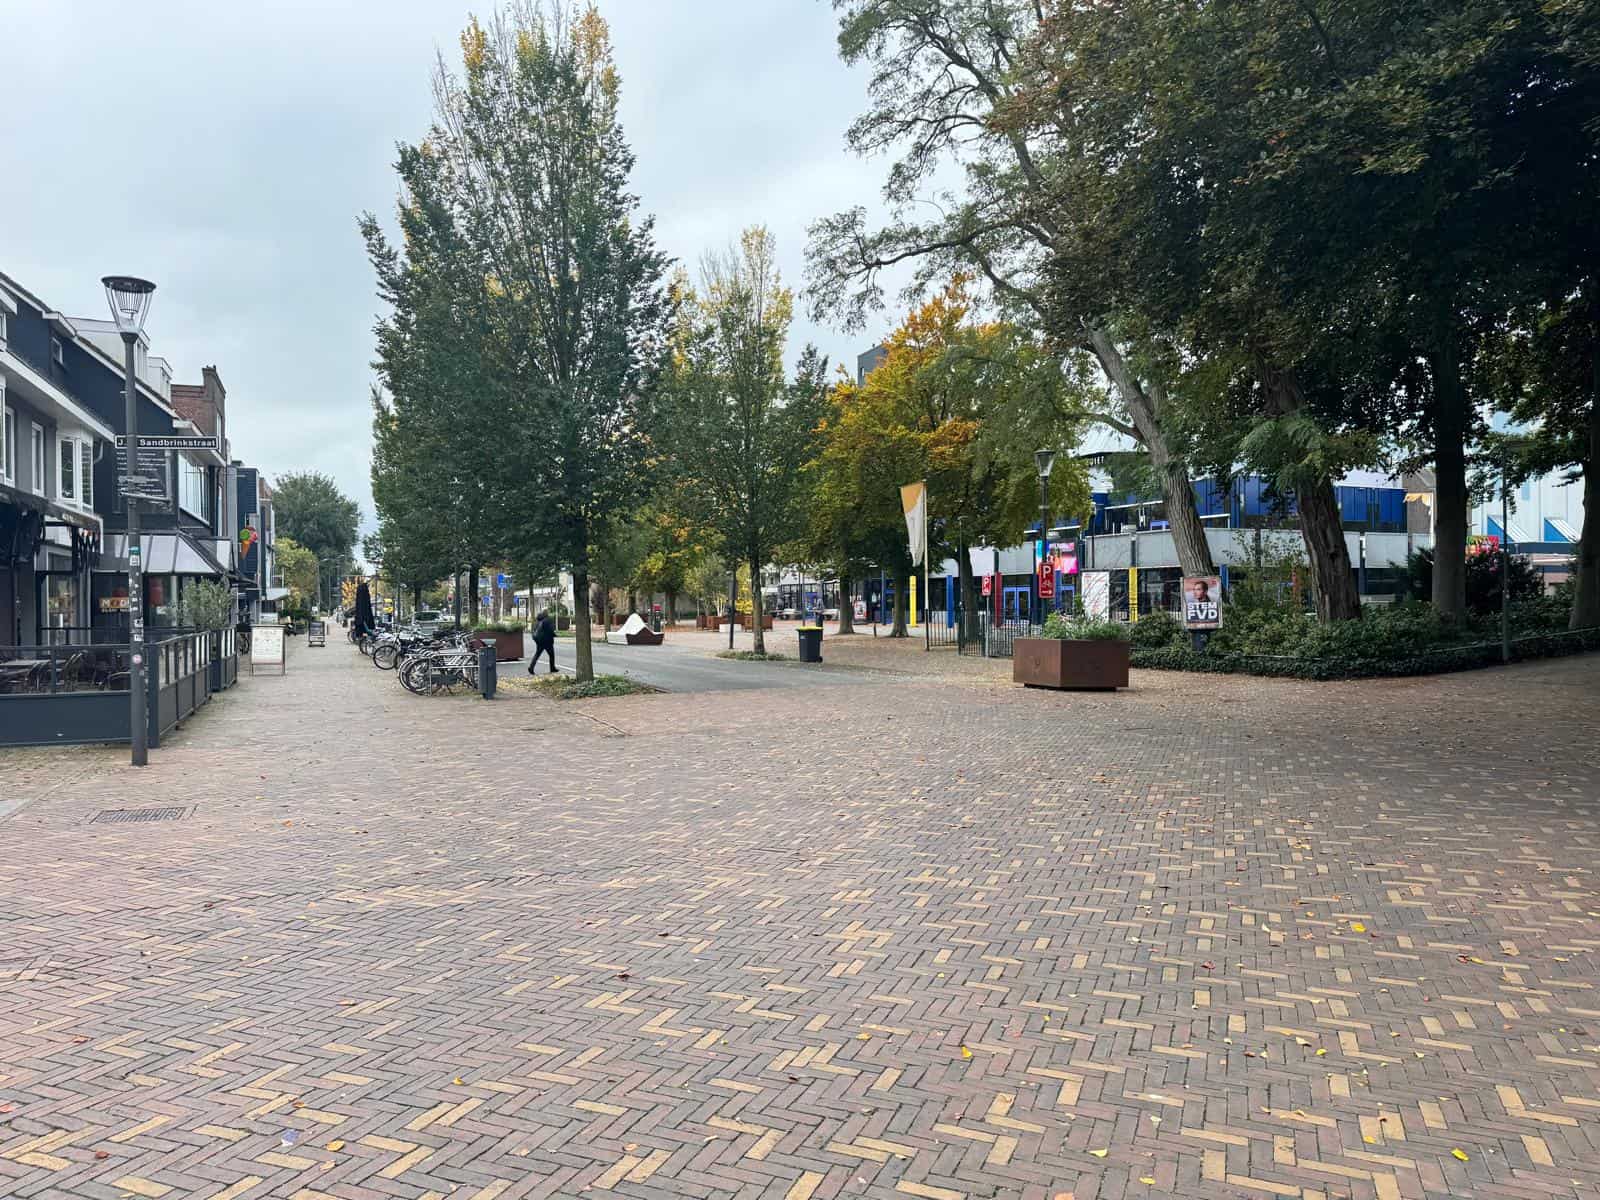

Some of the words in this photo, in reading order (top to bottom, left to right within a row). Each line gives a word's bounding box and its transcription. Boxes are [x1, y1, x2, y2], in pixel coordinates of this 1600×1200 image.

[139, 439, 216, 447] Sandbrinkstraat
[1042, 565, 1051, 579] P
[1187, 609, 1218, 620] FVD
